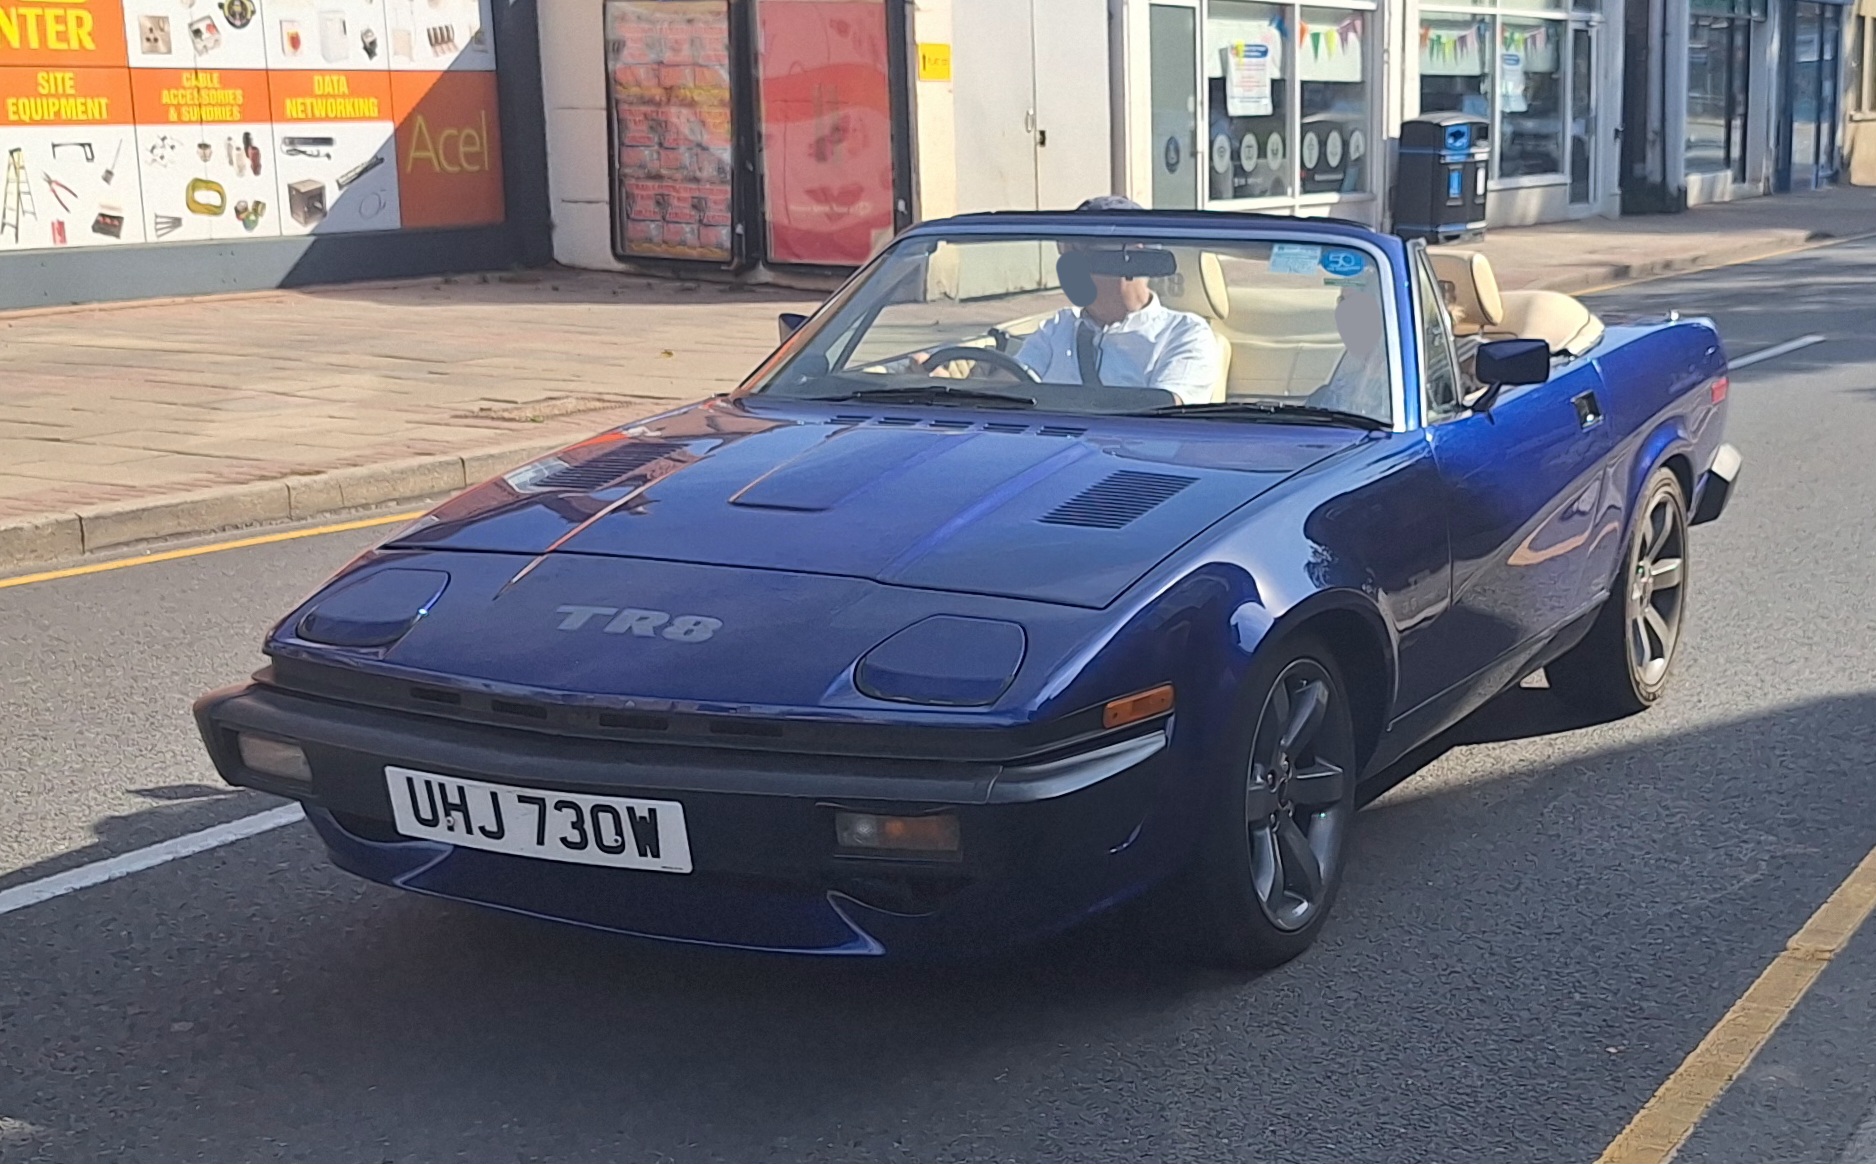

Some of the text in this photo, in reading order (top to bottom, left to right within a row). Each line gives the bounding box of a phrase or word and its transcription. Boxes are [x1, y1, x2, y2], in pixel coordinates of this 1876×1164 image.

[37, 70, 76, 95] SITE
[313, 75, 349, 95] DATA
[6, 96, 108, 122] EQUIPMENT
[162, 89, 244, 104] ACCESSORIES
[286, 97, 379, 118] NETWORKING
[169, 105, 241, 121] & SUNDRIES
[406, 110, 488, 173] Acel
[556, 604, 723, 643] TR8
[406, 776, 661, 859] UHJ 730W
